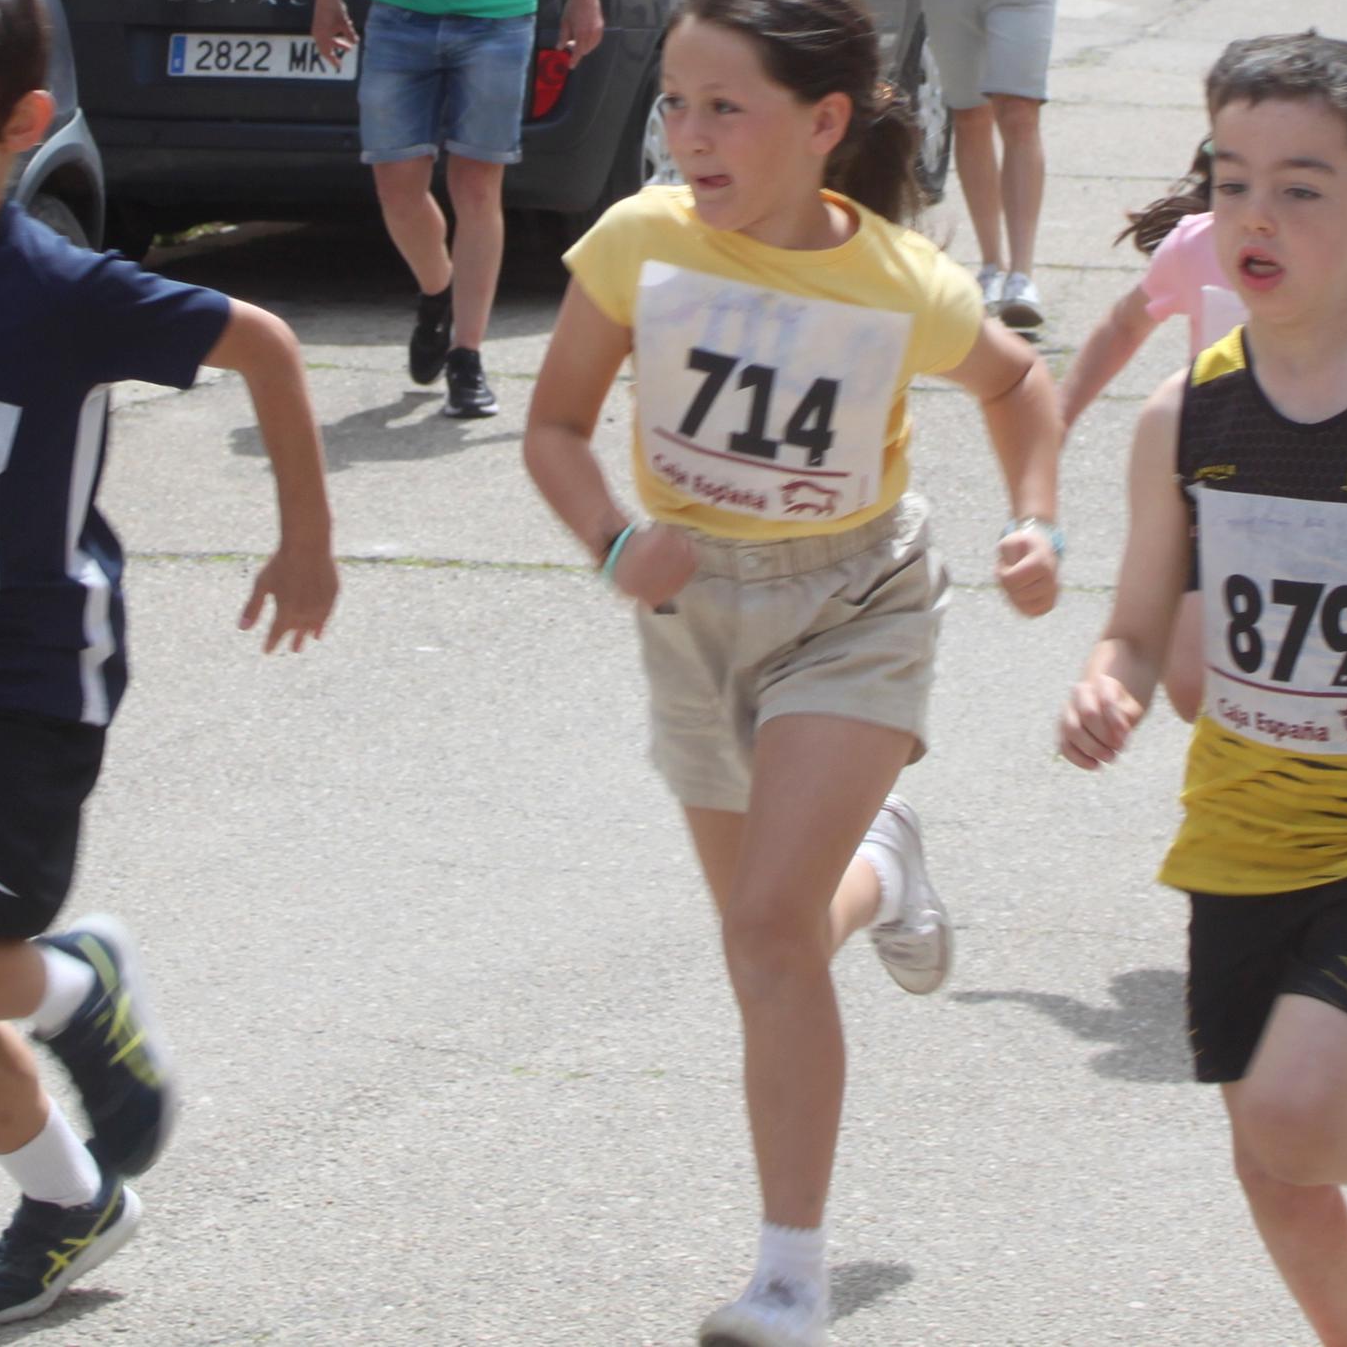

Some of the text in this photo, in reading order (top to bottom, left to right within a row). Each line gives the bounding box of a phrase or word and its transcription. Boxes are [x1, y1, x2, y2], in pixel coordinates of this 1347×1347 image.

[195, 40, 272, 72] 2822
[677, 347, 843, 467] 714
[1218, 698, 1330, 742] Caja España
